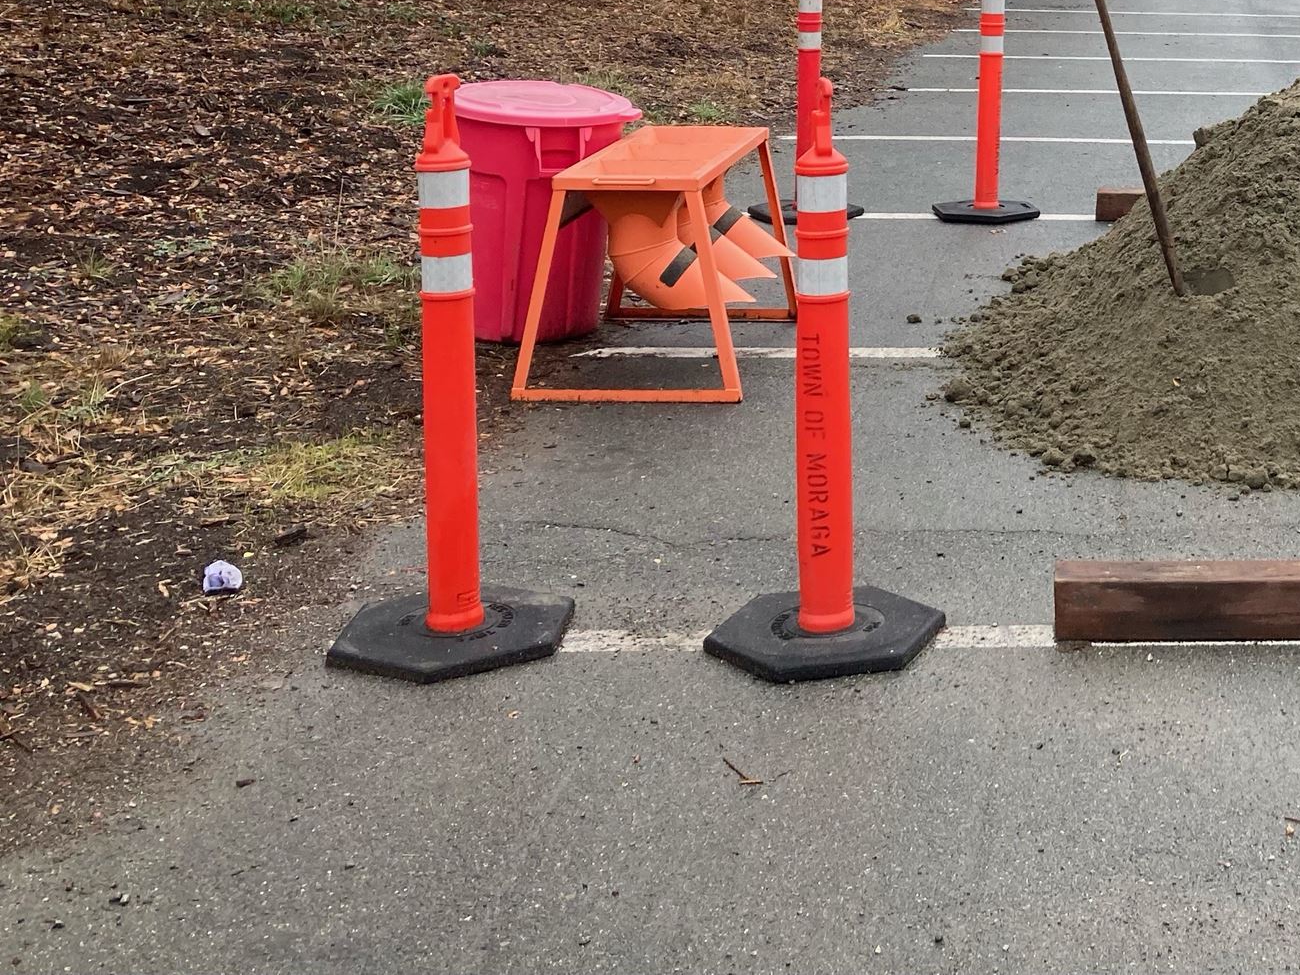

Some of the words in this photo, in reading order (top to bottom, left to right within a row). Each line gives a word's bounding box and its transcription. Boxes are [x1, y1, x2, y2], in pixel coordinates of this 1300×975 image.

[801, 333, 823, 397] TOWN
[804, 410, 826, 440] OF
[806, 453, 832, 558] MORAGA
